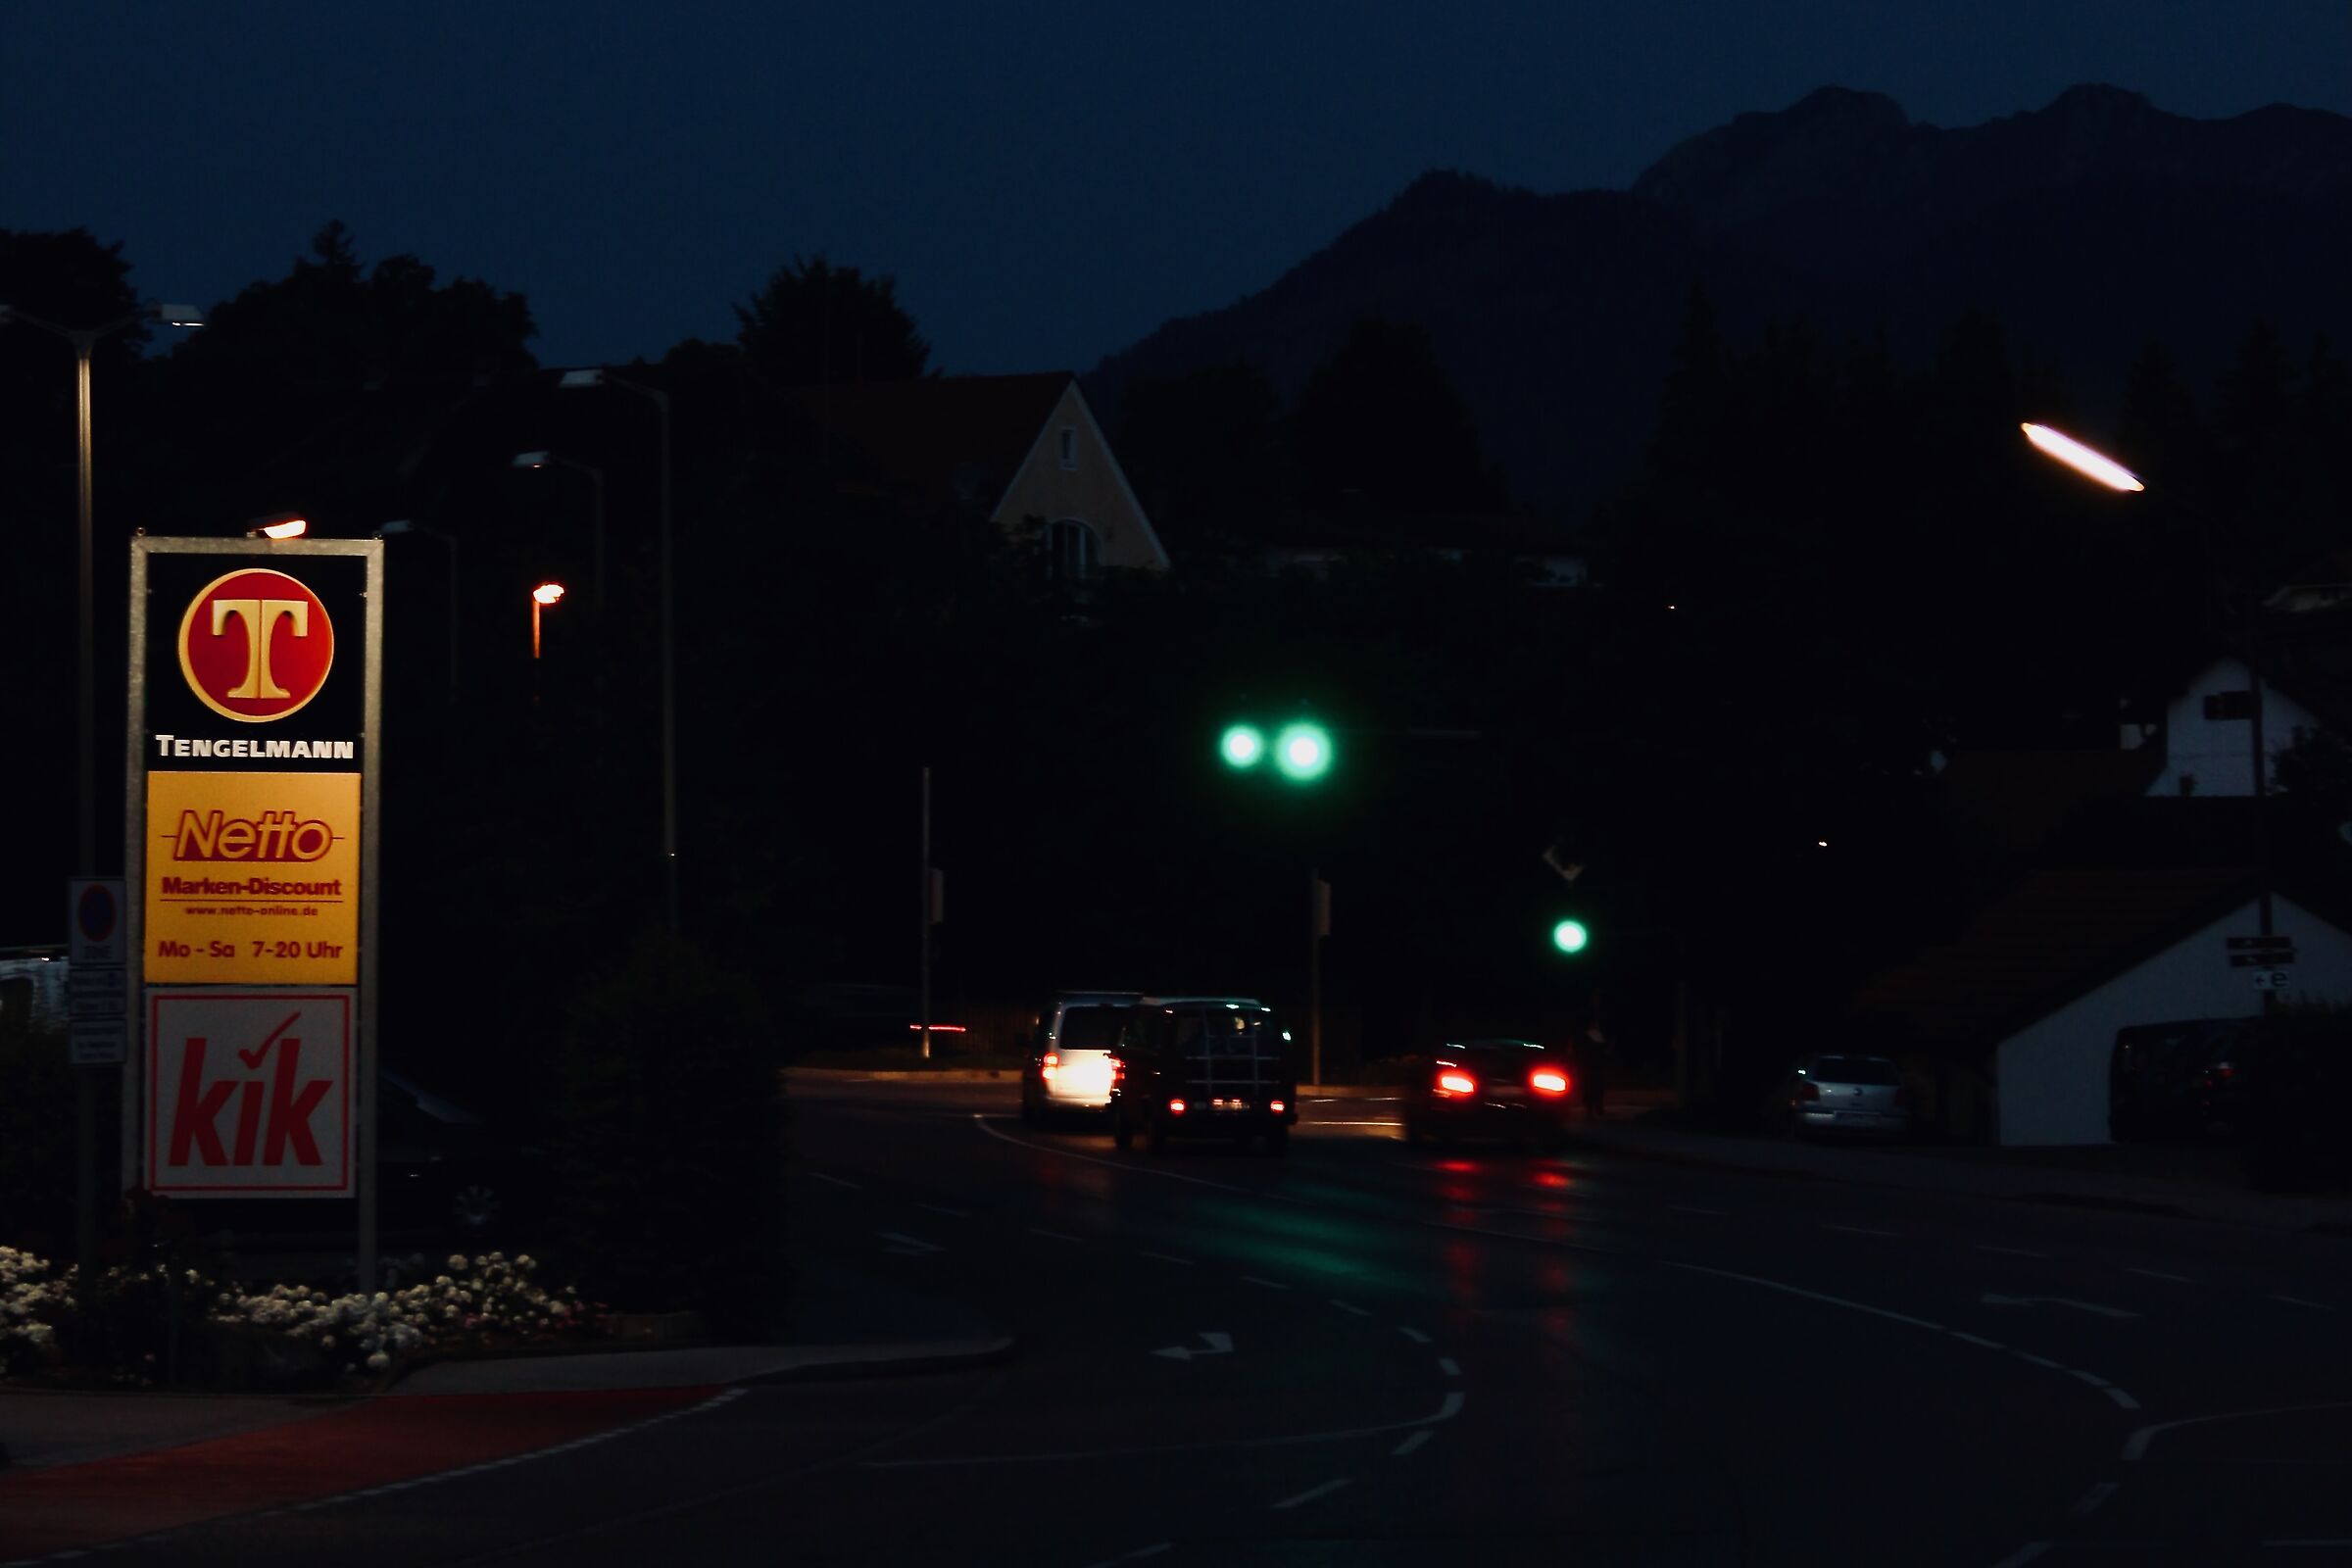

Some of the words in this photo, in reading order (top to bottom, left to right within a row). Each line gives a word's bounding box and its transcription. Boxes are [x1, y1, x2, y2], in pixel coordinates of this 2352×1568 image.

[212, 599, 309, 699] T
[155, 734, 354, 760] TENGELMANN
[173, 809, 333, 862] Netto
[162, 877, 342, 896] Marken-Discount
[184, 905, 318, 917] www.netto-online.de
[159, 941, 190, 957] Mo
[209, 941, 235, 958] Sa
[252, 941, 301, 958] 7-20
[307, 941, 343, 958] Uhr
[168, 1037, 333, 1166] kik
